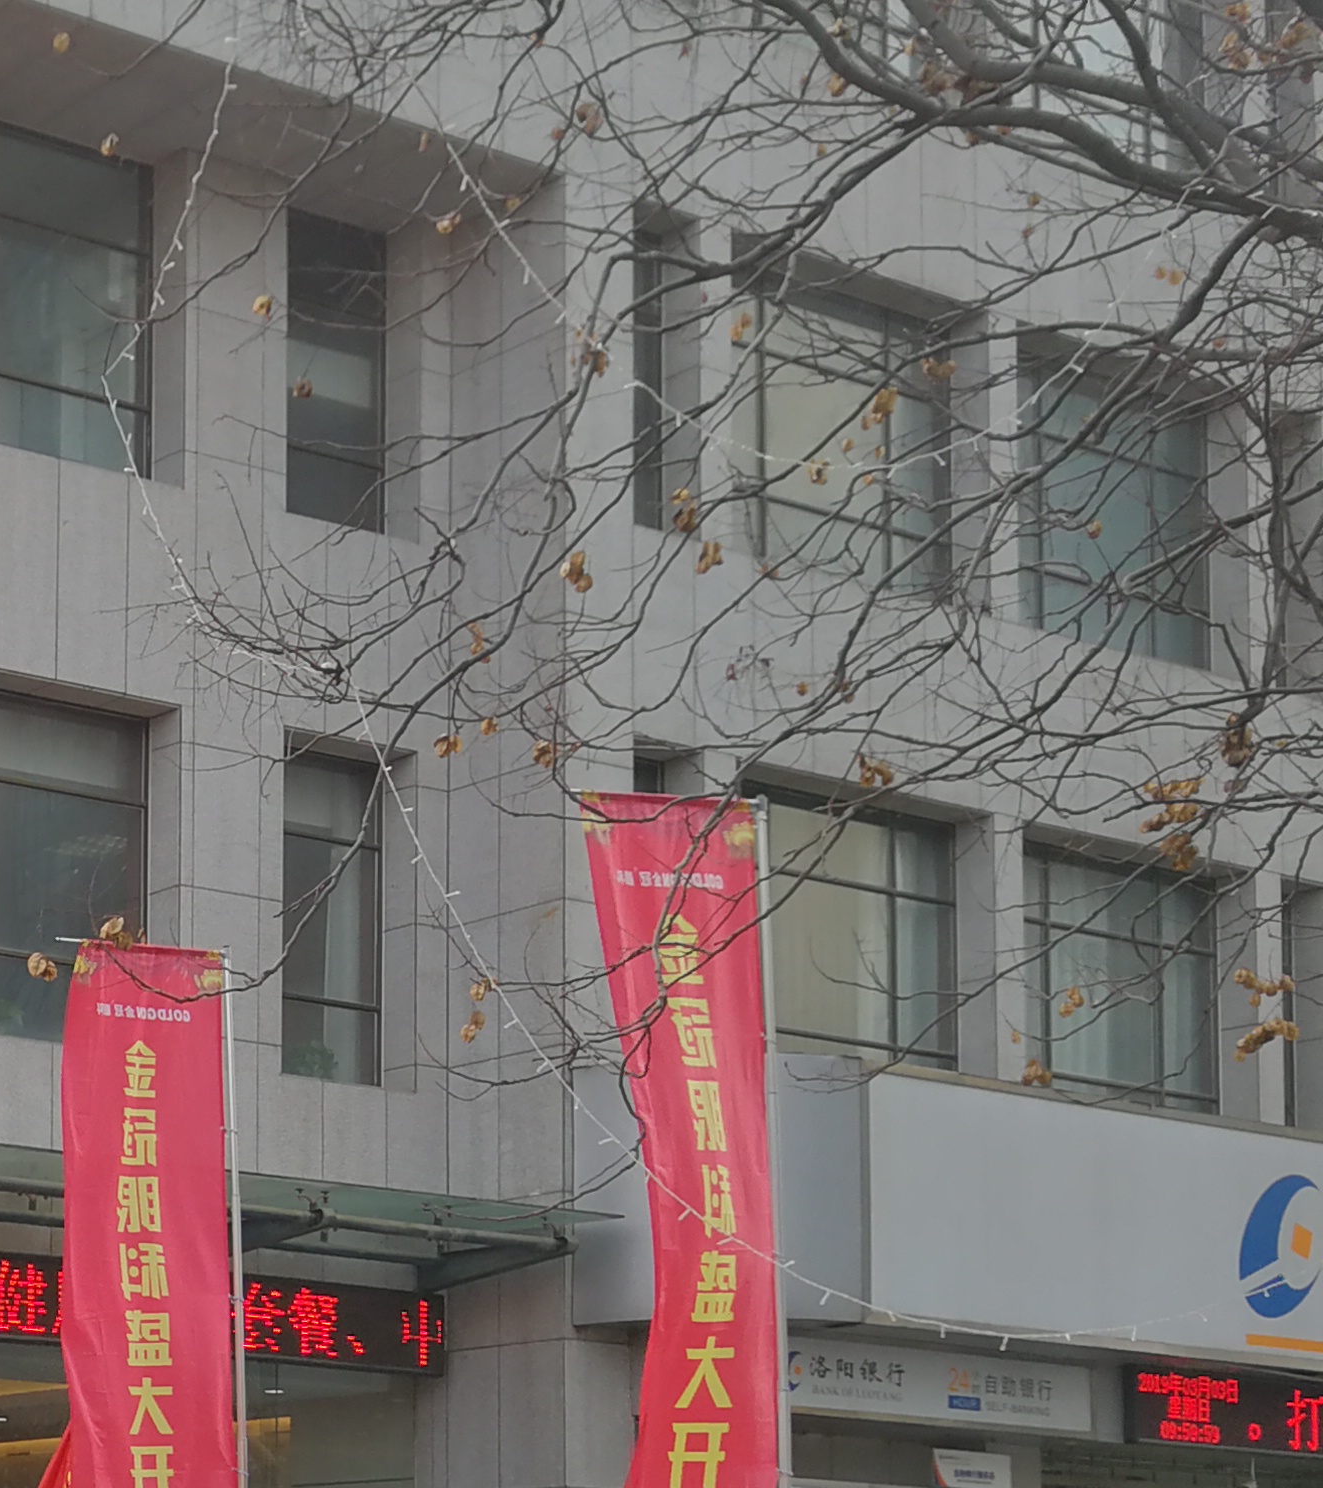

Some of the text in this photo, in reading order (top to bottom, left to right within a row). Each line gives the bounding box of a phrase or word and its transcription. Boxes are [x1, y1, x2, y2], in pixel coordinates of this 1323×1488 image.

[809, 1354, 905, 1388] 洛阳银行
[984, 1374, 1054, 1402] 自助银行
